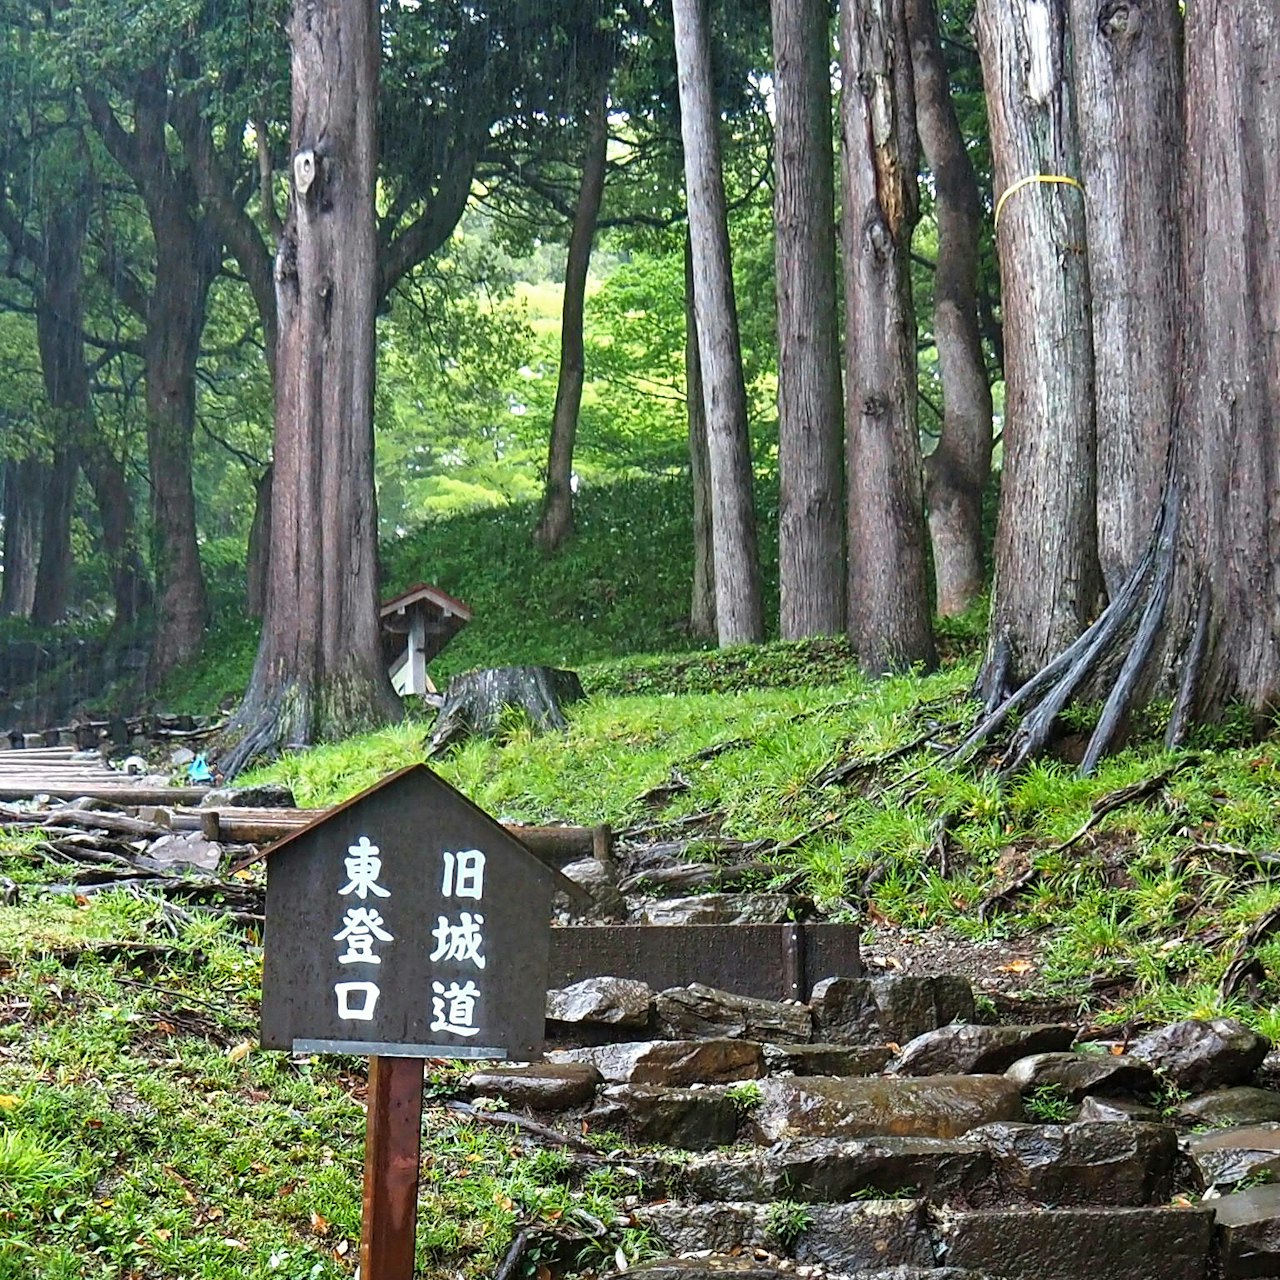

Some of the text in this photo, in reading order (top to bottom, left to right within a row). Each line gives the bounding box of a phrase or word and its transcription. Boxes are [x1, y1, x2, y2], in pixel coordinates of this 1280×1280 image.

[332, 835, 395, 1022] 東登口
[429, 849, 487, 1038] 旧城道
